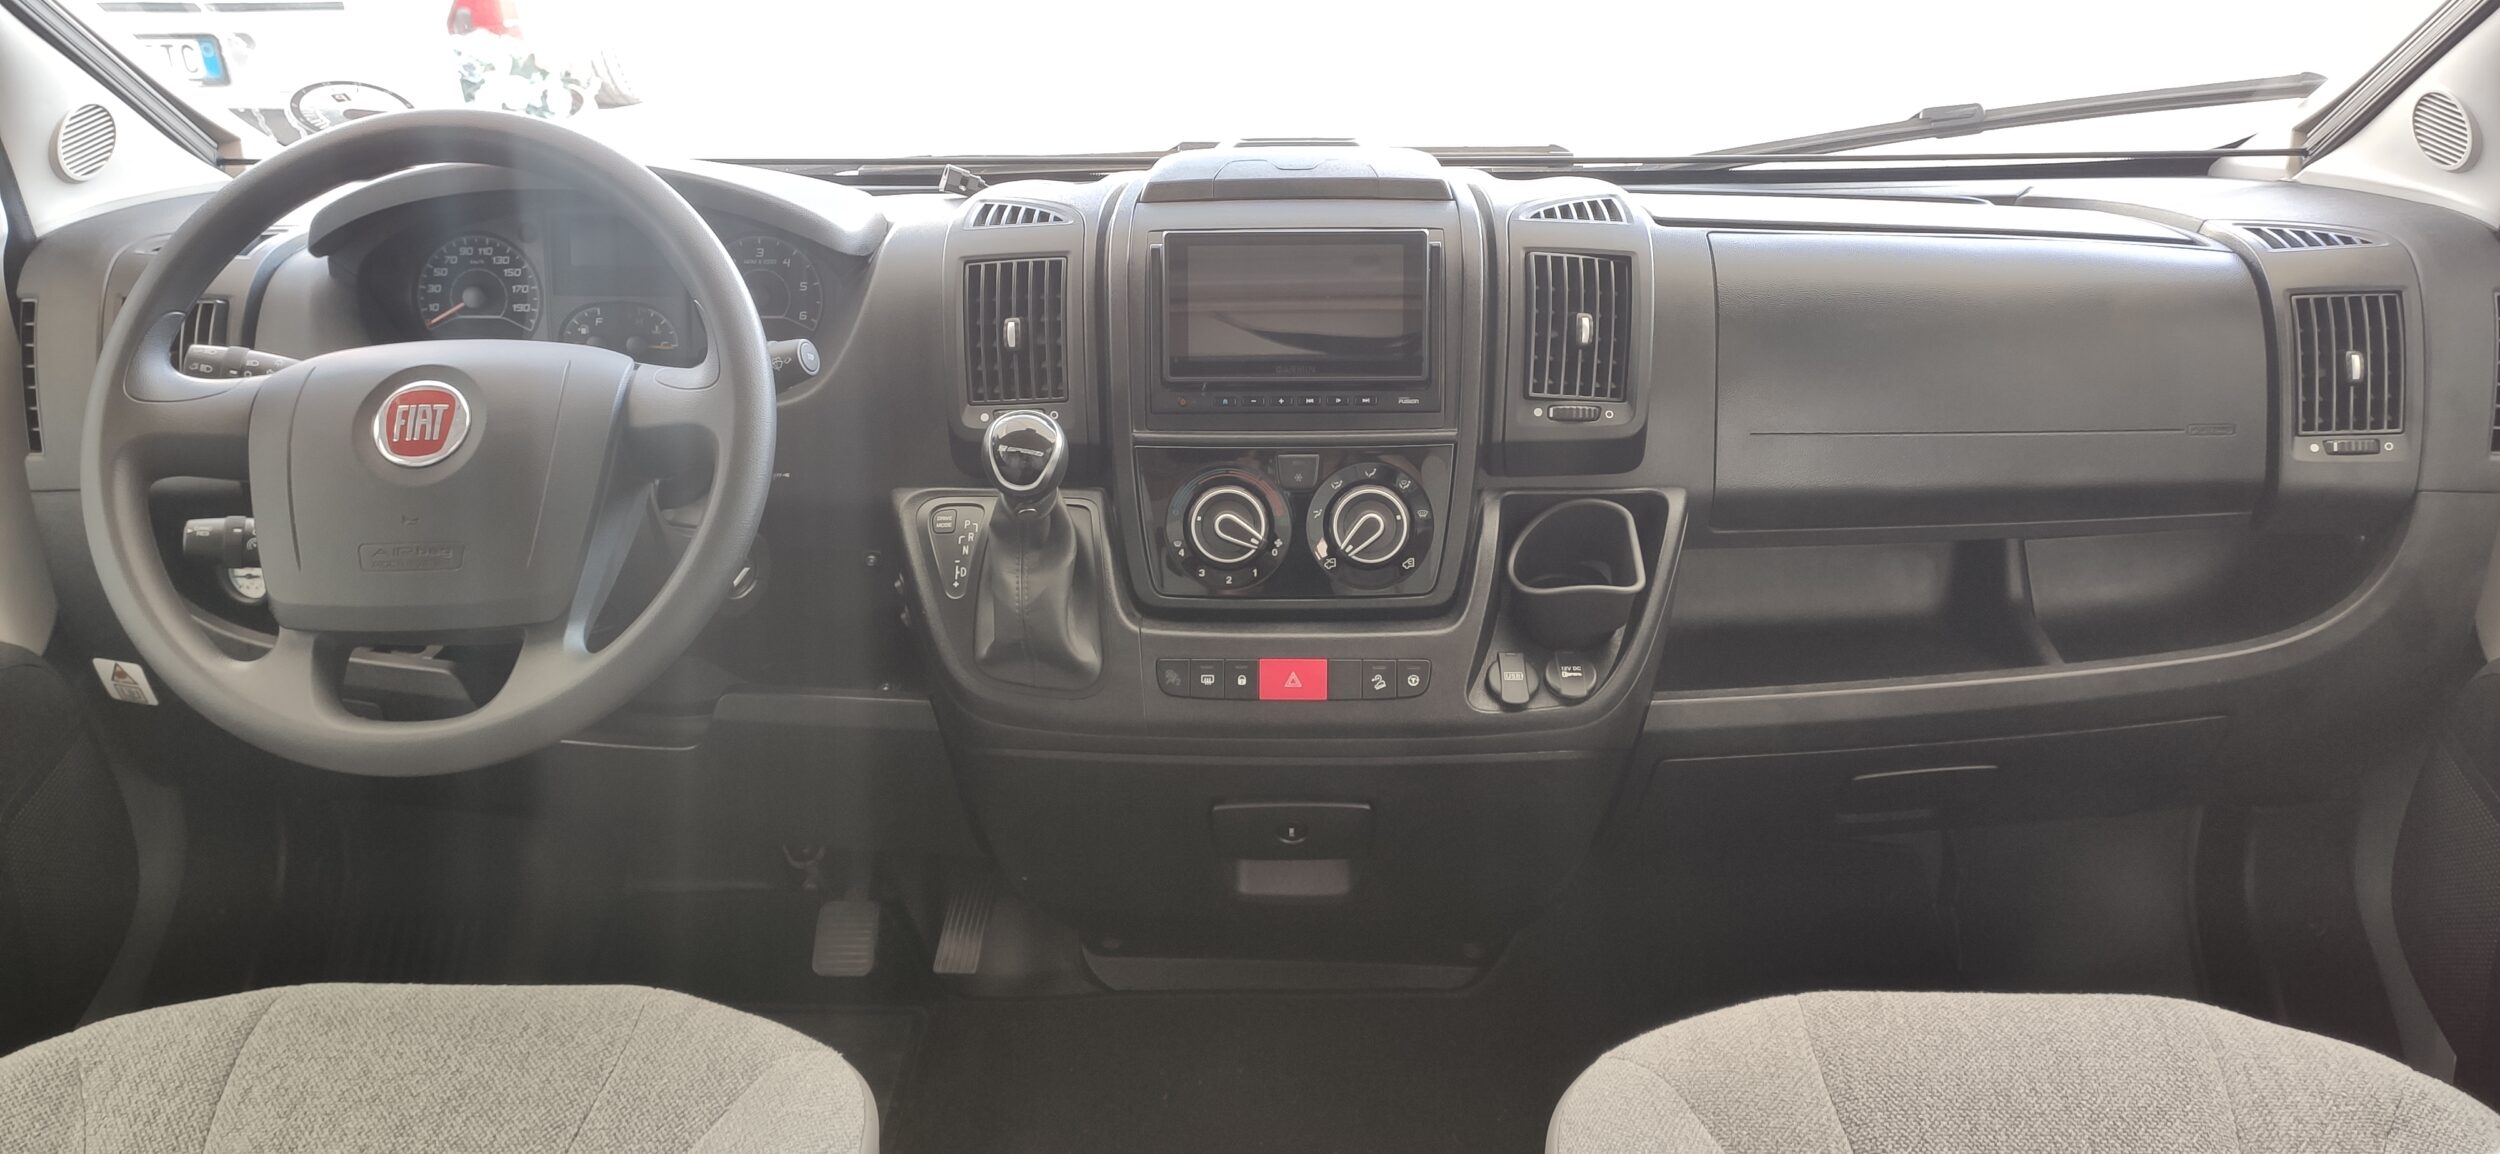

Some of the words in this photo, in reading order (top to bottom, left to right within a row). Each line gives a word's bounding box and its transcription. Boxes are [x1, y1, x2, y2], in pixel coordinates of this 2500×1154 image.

[459, 247, 473, 256] 90
[478, 247, 493, 256] 110
[755, 247, 764, 258] 3
[444, 255, 458, 265] 70
[492, 256, 510, 265] 130
[782, 258, 791, 268] 4
[433, 267, 448, 277] 50
[503, 268, 521, 277] 150
[427, 284, 441, 294] 30
[512, 285, 529, 294] 170
[799, 281, 808, 292] 5
[428, 303, 440, 312] 10
[512, 303, 530, 313] 190
[798, 311, 807, 320] 6
[595, 317, 603, 327] F
[393, 403, 449, 442] FIAT
[964, 520, 971, 529] P
[968, 532, 974, 542] R
[962, 545, 969, 555] N
[1178, 548, 1185, 557] 4
[1271, 548, 1278, 557] 0
[960, 567, 967, 577] D
[1199, 569, 1206, 577] 3
[1252, 568, 1258, 577] 1
[1225, 576, 1233, 584] 2
